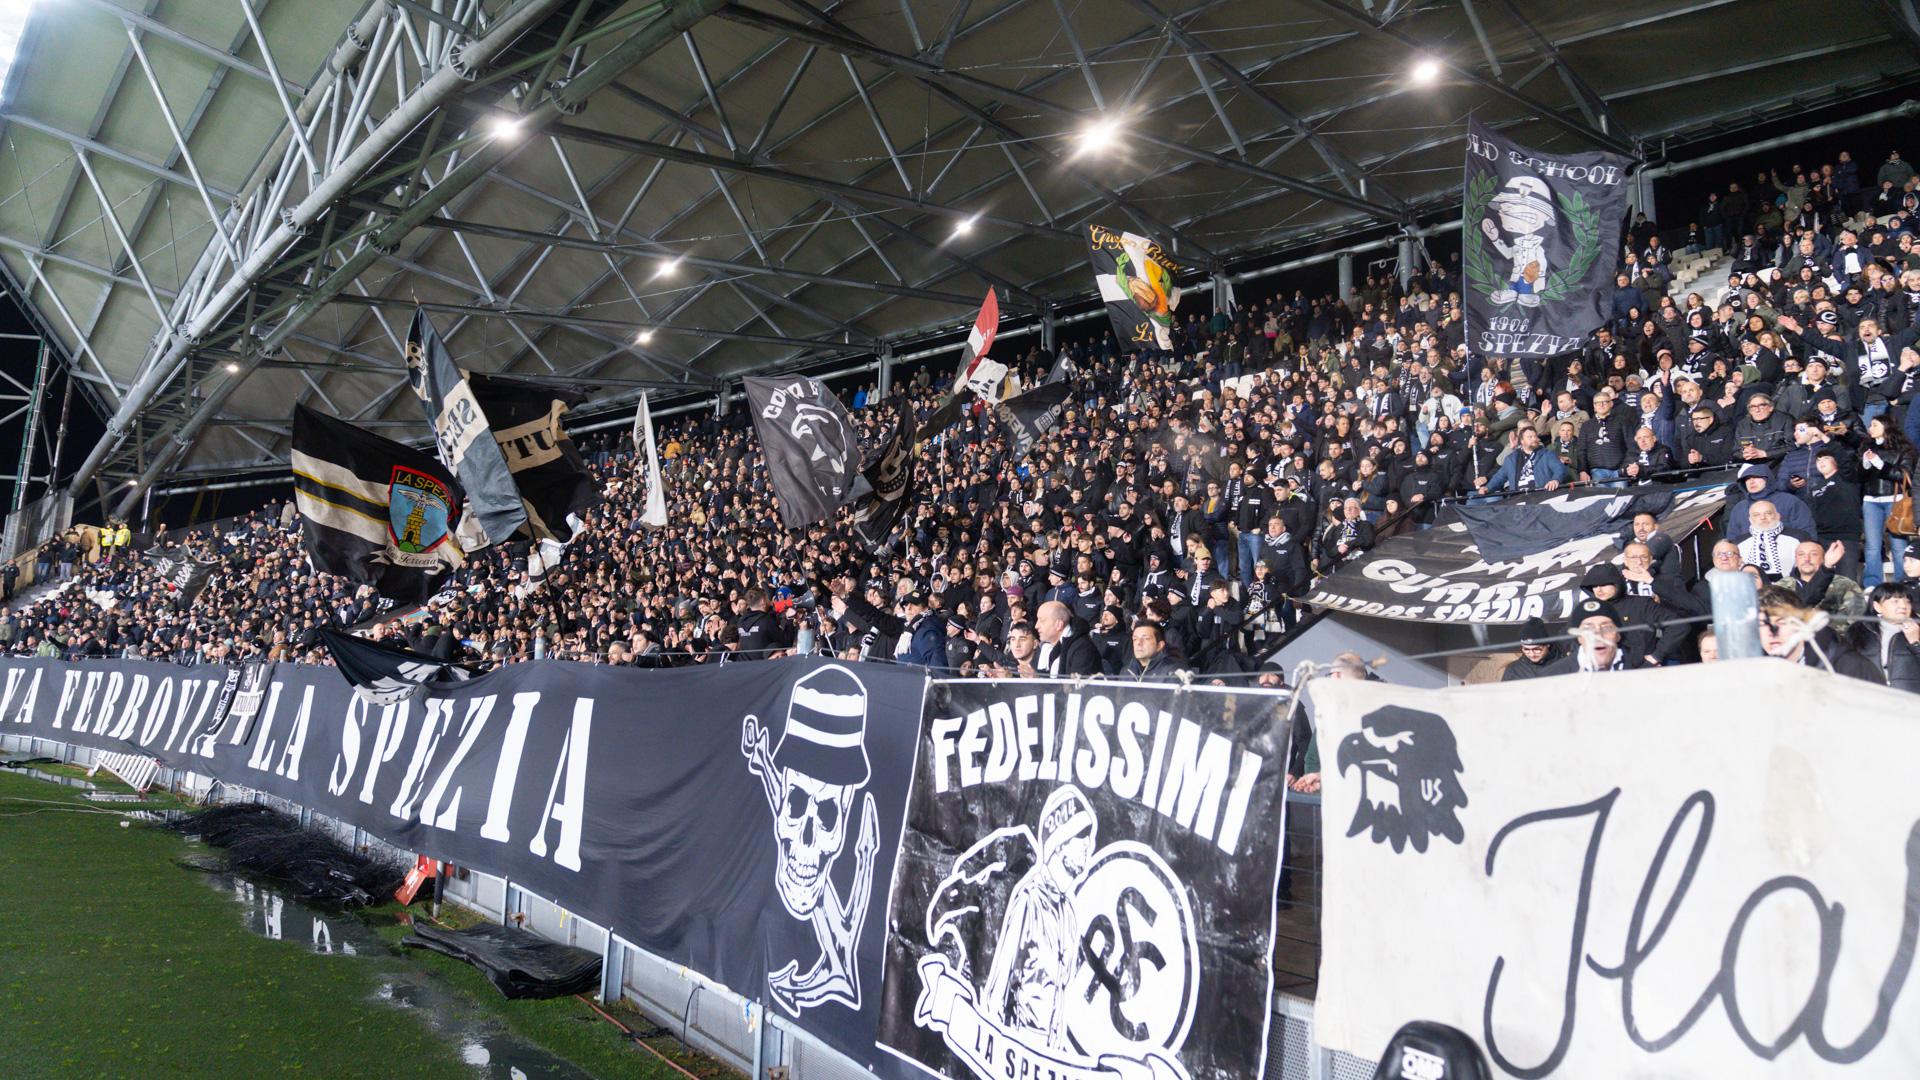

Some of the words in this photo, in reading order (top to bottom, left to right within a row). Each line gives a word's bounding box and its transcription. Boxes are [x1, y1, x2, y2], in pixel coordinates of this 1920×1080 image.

[1489, 316, 1530, 332] 1906
[1478, 331, 1580, 355] SPEZIA
[396, 471, 411, 485] LA
[1424, 596, 1545, 622] SPEZIA
[248, 681, 315, 781] LA
[328, 690, 595, 873] SPEZIA
[931, 693, 1263, 856] FEDELISSIMI
[1420, 777, 1444, 806] US
[1044, 797, 1077, 833] 2014
[975, 1023, 995, 1065] LA
